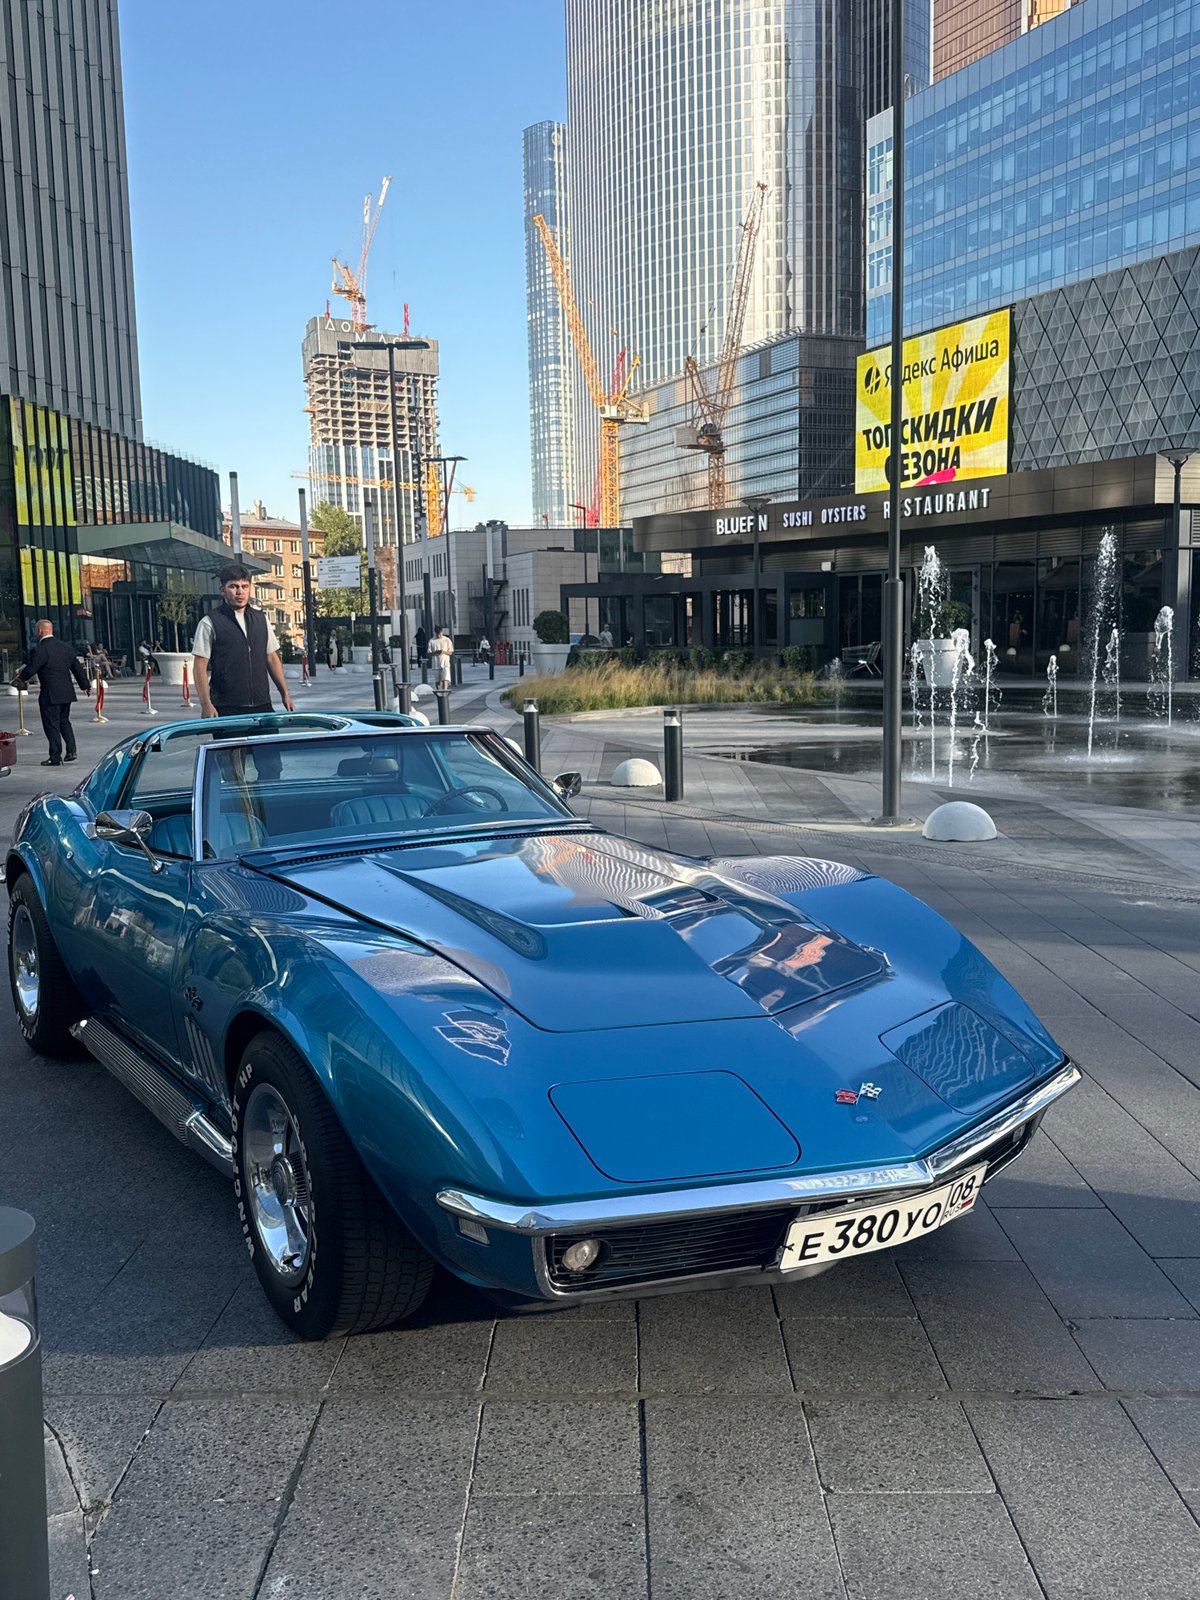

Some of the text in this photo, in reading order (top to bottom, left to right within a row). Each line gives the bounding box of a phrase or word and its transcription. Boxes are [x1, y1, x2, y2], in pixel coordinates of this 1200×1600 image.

[885, 339, 999, 388] Ядекс Афиша
[899, 396, 998, 446] СКИДКИ
[716, 488, 990, 535] BLUEFN SUSHI OYSTERS RSTAURANT
[239, 1063, 253, 1089] HP
[949, 1174, 977, 1208] 08
[943, 1203, 962, 1223] RUS
